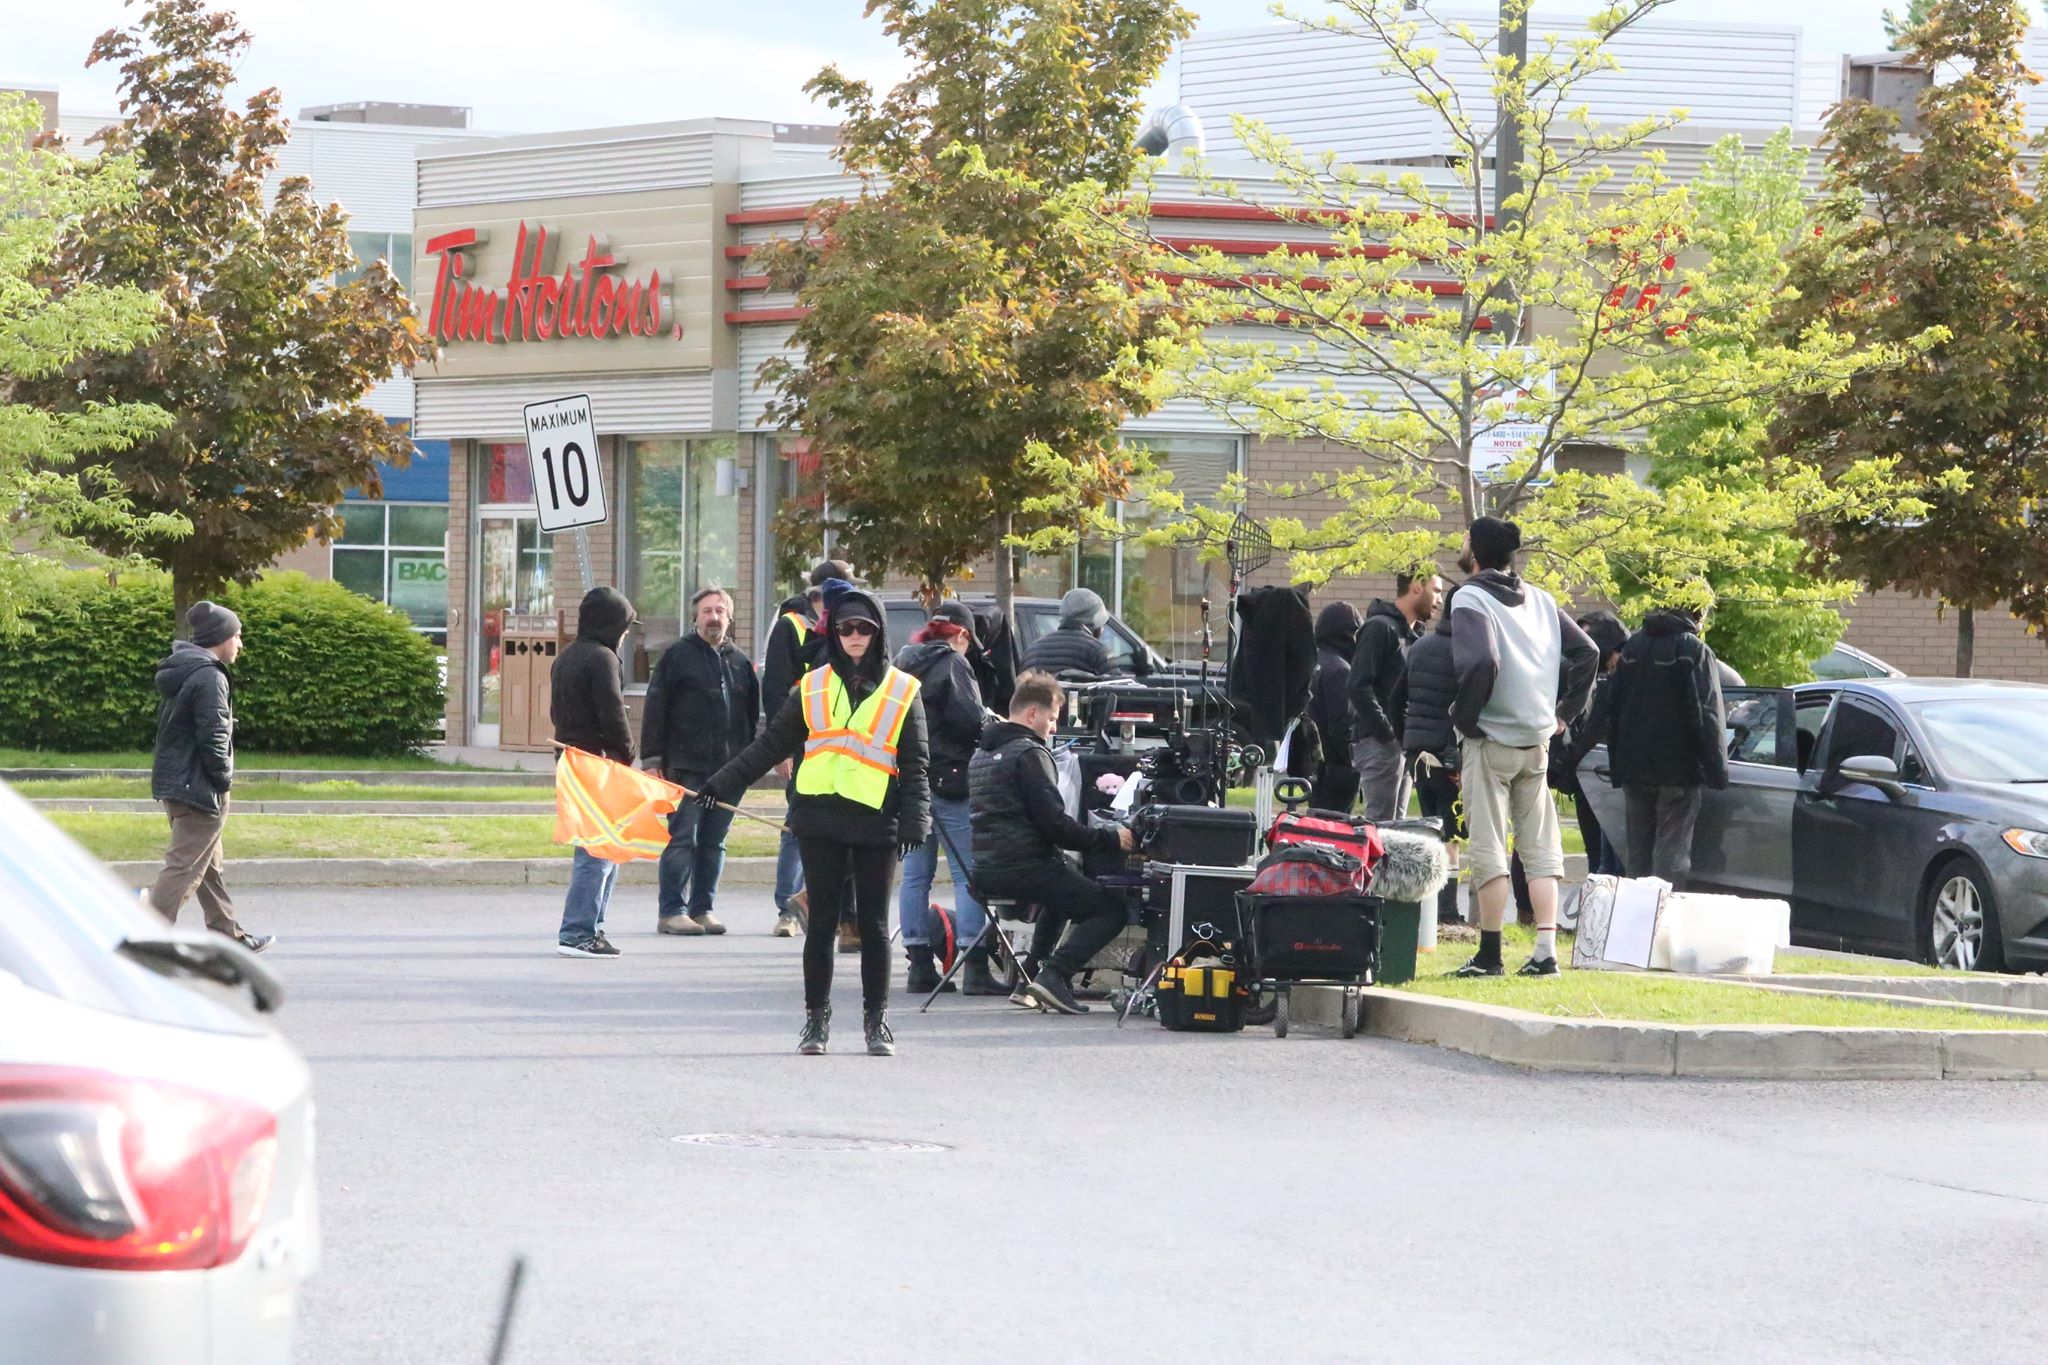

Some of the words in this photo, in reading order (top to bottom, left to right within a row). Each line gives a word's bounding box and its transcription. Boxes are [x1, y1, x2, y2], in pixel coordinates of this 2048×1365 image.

[426, 228, 499, 345] Tim
[502, 219, 664, 343] Hortons
[530, 408, 587, 432] MAXIMUM
[542, 442, 589, 510] 10
